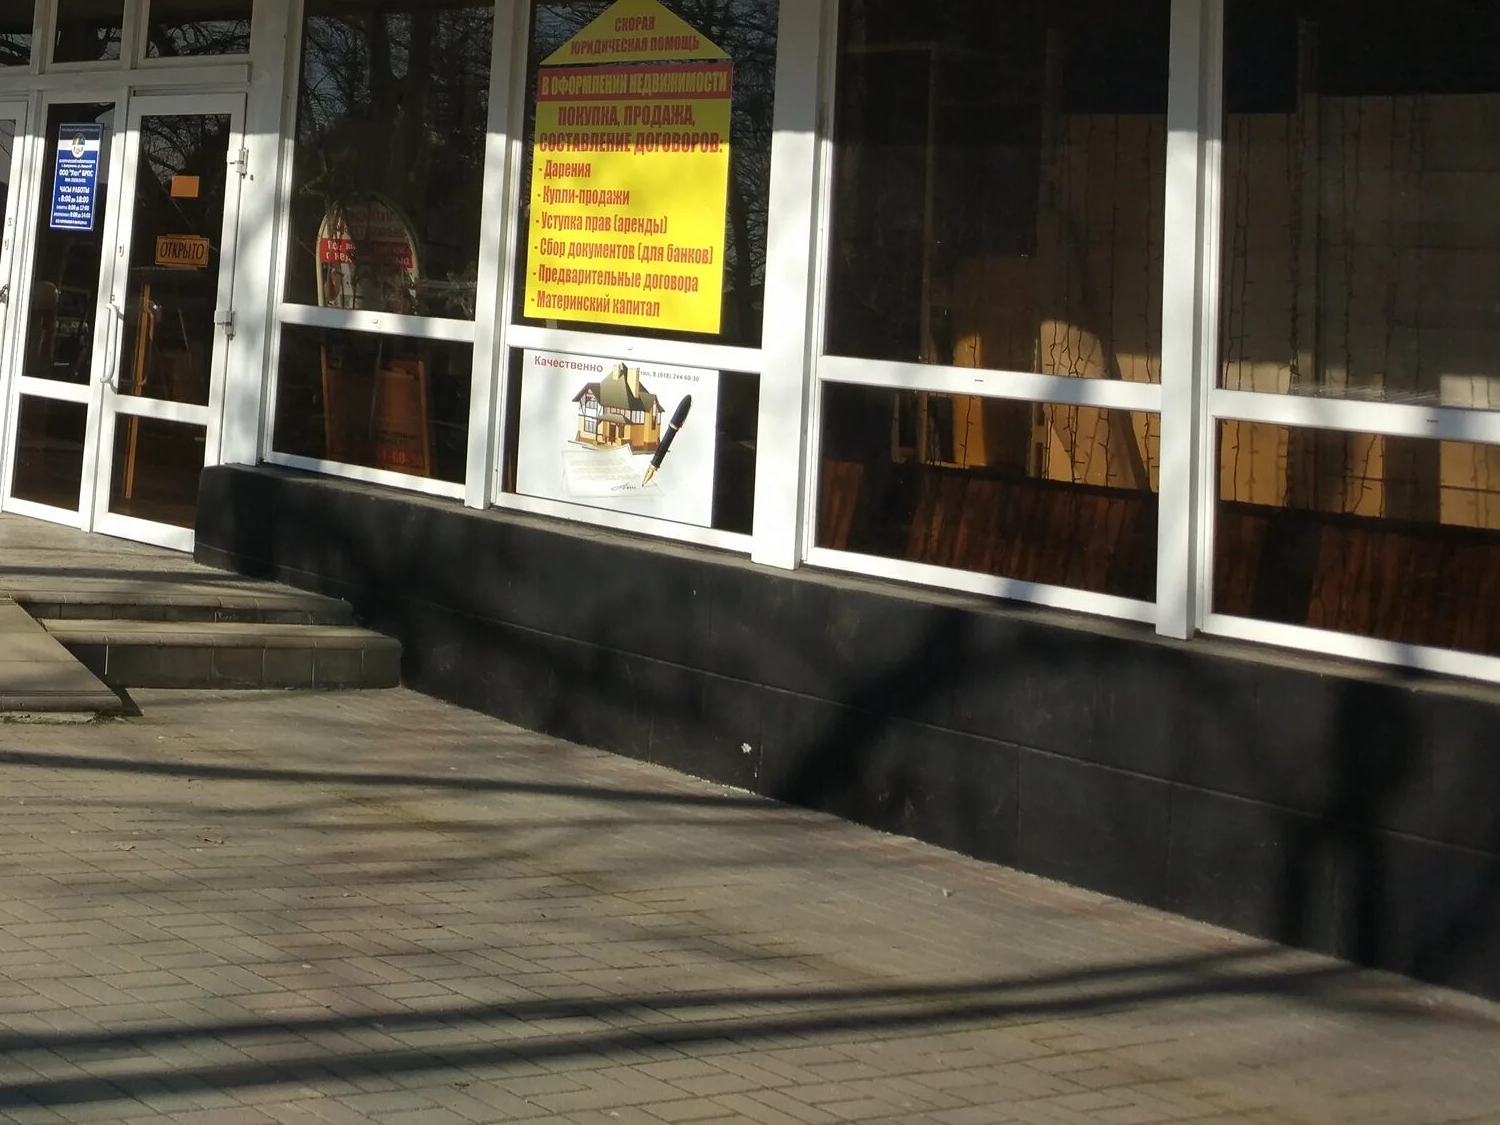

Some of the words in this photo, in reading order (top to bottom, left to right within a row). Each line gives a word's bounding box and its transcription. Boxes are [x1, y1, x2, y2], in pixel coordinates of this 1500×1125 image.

[614, 16, 656, 32] СКОРАЯ
[570, 37, 647, 56] ЮРИДИЧЕСКАЯ
[650, 35, 700, 54] ПОМОЩЬ
[541, 76, 549, 96] В
[551, 73, 627, 95] ОФОРМЛЕНИИ
[629, 70, 728, 96] НЕДВИЖИМОСТИ
[558, 105, 621, 127] ПОКУПКА,
[623, 105, 696, 128] ПРОДАЖА,
[539, 132, 632, 152] СОСТАВЛЕНИЕ
[634, 131, 724, 156] ДОГОВОРОВ:
[543, 159, 592, 180] Дарения
[542, 186, 630, 208] Купли-продажи
[541, 211, 583, 233] Уступка
[584, 215, 611, 232] прав
[159, 241, 205, 260] ОТКРЫТО
[539, 237, 566, 257] Сбор
[567, 241, 635, 260] документов
[538, 263, 641, 288] Предварительные
[643, 273, 699, 293] договора
[536, 290, 610, 313] Материнский
[612, 298, 661, 318] капитал
[533, 355, 604, 373] Качественно
